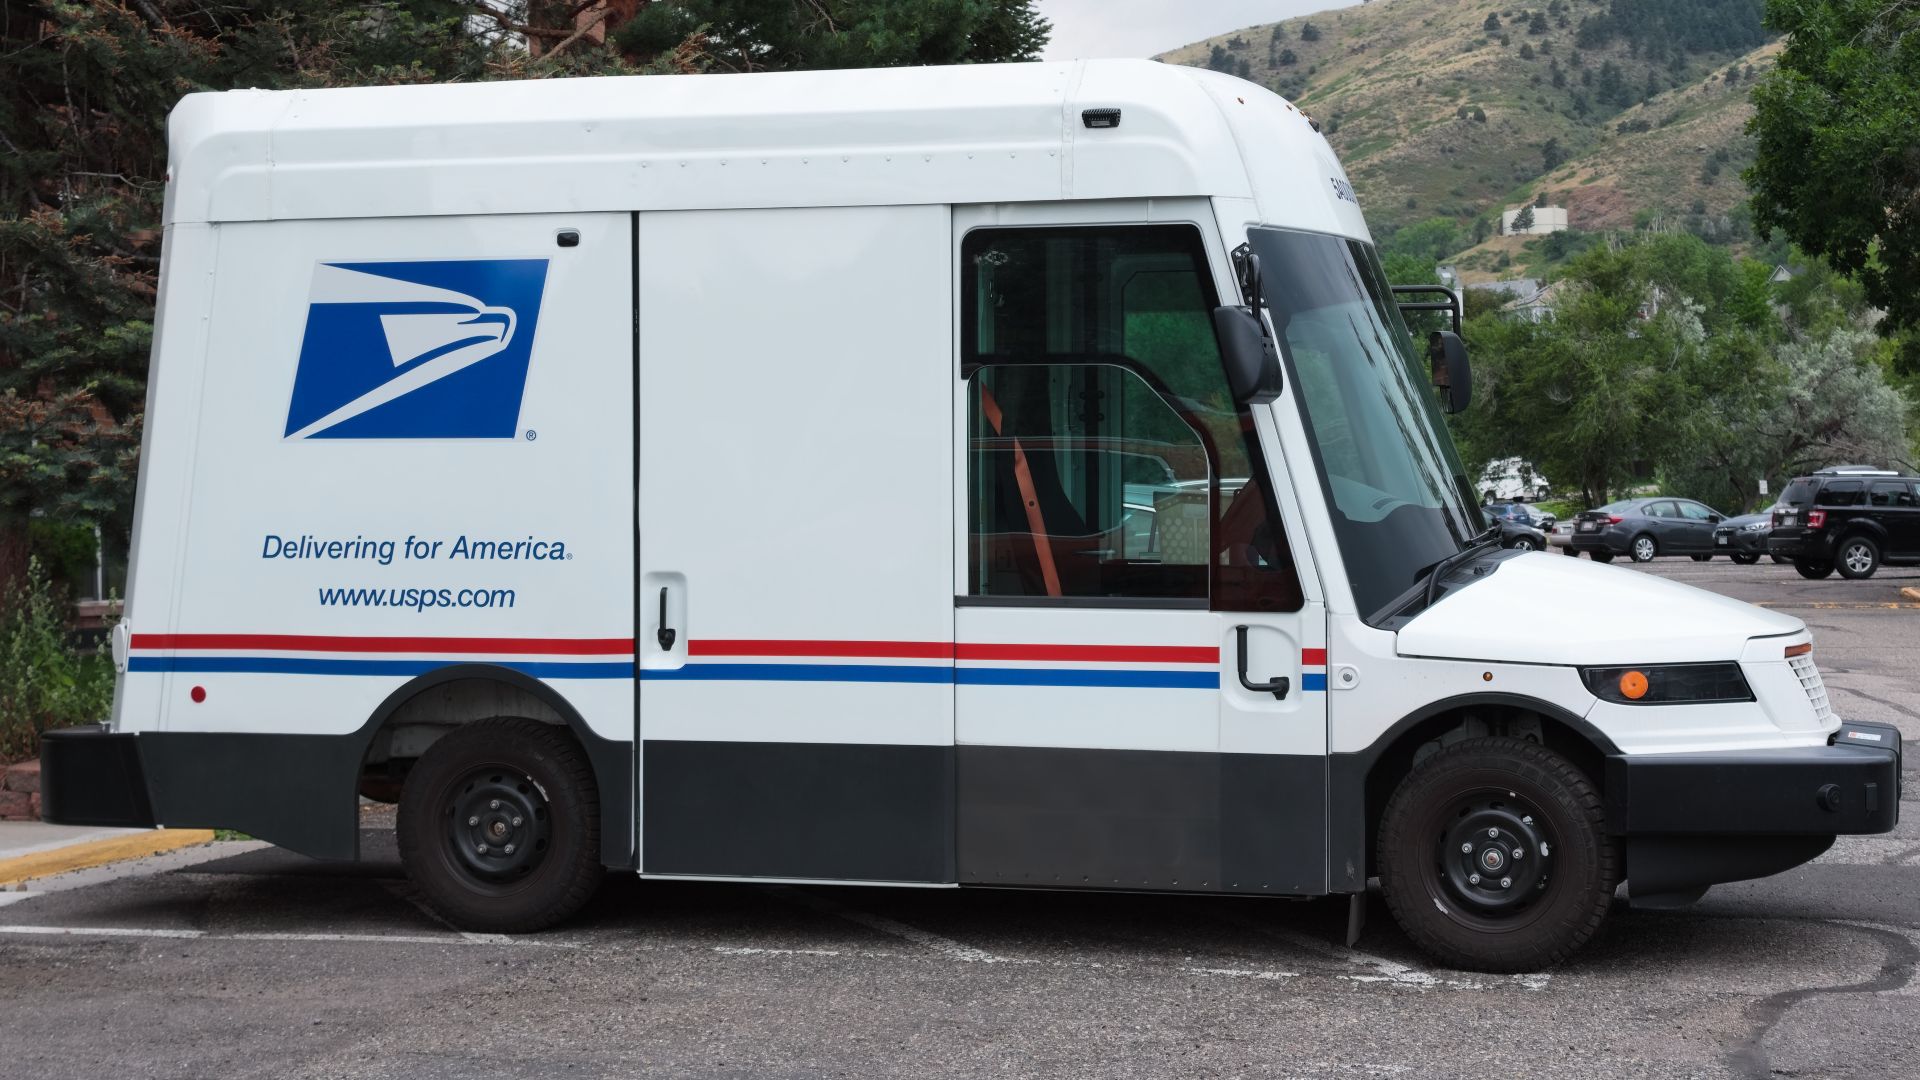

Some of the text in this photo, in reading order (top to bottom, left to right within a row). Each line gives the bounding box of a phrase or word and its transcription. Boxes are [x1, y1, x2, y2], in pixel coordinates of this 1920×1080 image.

[262, 534, 396, 566] Delivering
[404, 534, 444, 560] for
[318, 587, 516, 614] www.usps.com
